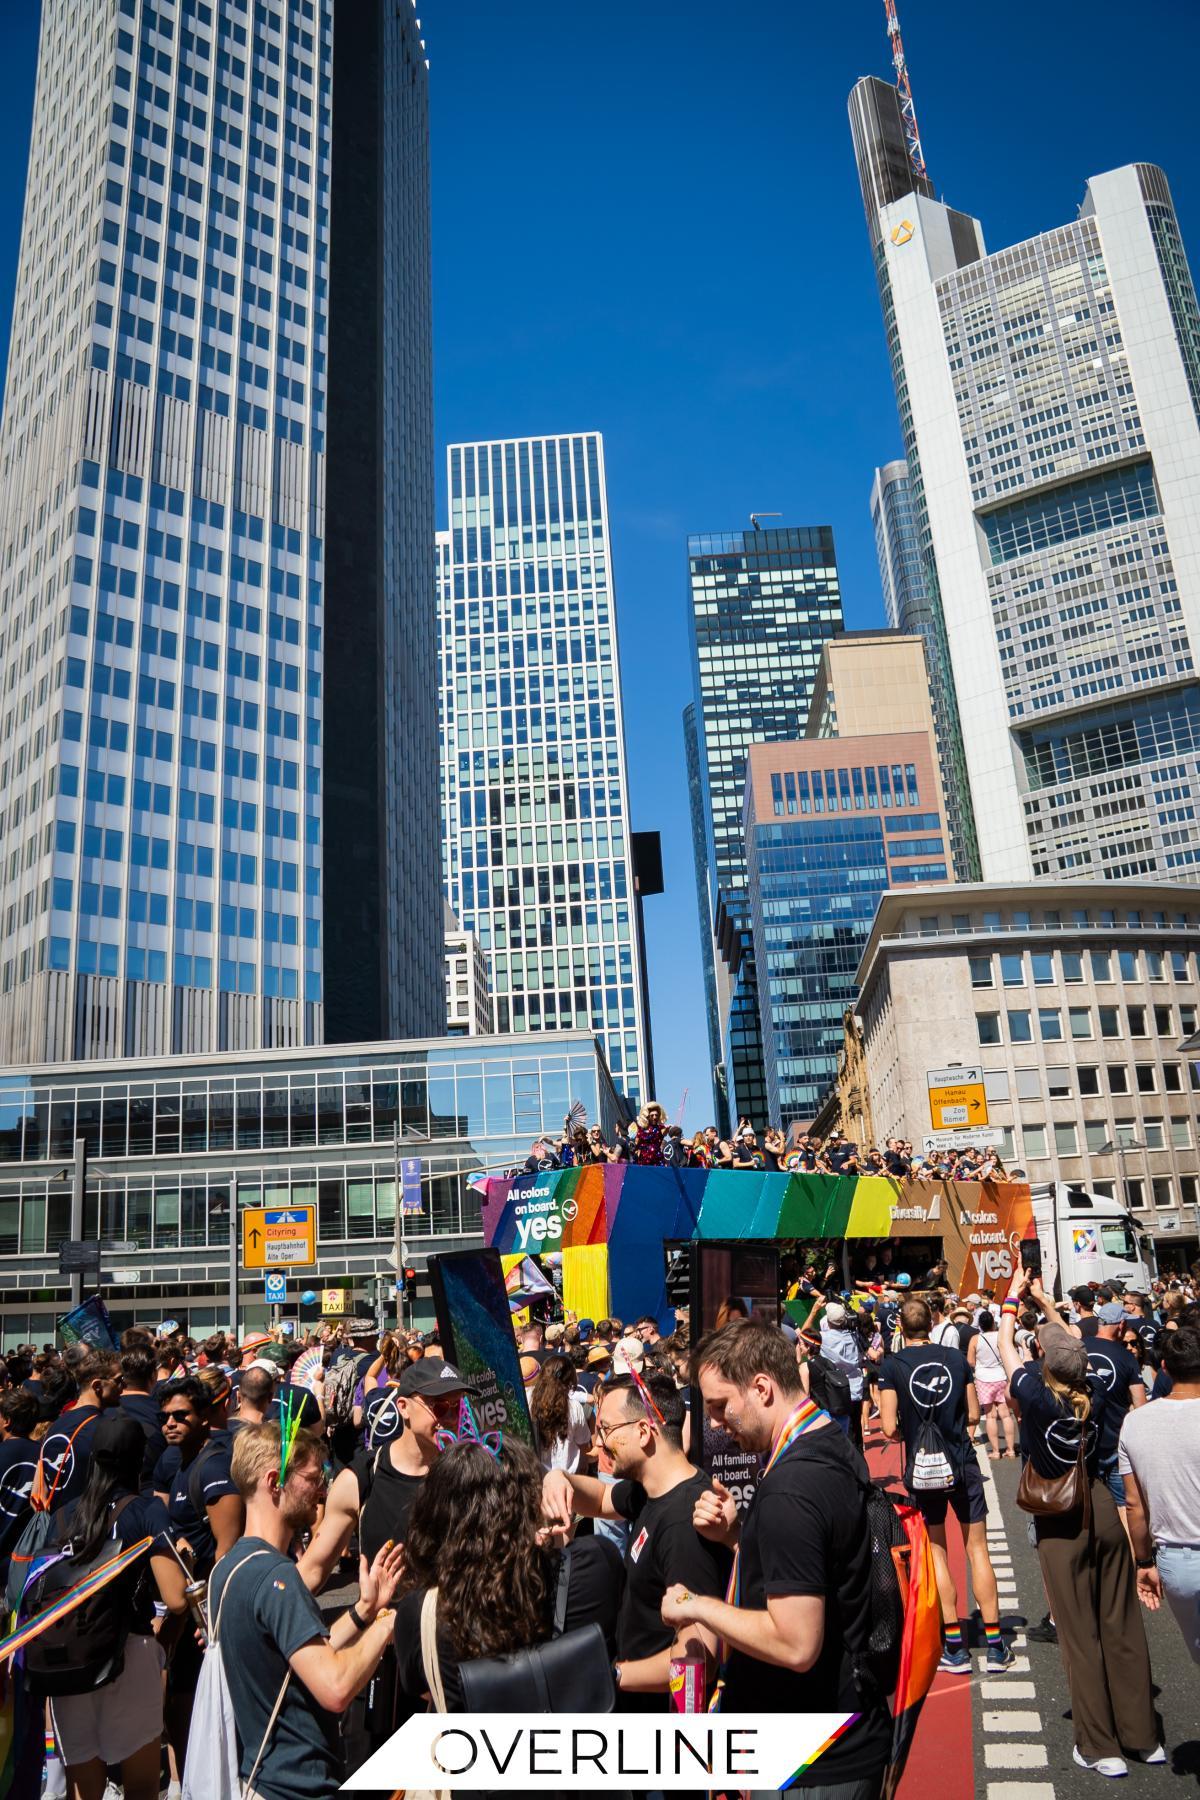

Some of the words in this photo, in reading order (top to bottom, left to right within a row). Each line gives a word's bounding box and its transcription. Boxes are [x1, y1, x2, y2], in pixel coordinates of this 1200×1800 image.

[933, 1097, 967, 1105] Offenbach
[506, 1189, 520, 1201] All
[521, 1187, 550, 1199] colors
[515, 1206, 527, 1215] on
[528, 1199, 559, 1213] board.
[960, 1210, 972, 1225] All
[972, 1210, 998, 1224] colors
[267, 1228, 297, 1237] Cityring
[515, 1215, 562, 1249] yes
[969, 1233, 981, 1245] on
[981, 1229, 1007, 1244] board.
[267, 1241, 306, 1251] Hauptbahnhof
[281, 1252, 294, 1261] Oper
[972, 1249, 1012, 1290] yes
[268, 1292, 284, 1300] TAXI
[323, 1303, 343, 1311] TAXI
[467, 1373, 476, 1385] All
[476, 1368, 496, 1383] colors
[480, 1383, 499, 1398] oard.
[712, 1454, 723, 1467] All
[724, 1453, 757, 1466] families
[712, 1472, 723, 1481] on
[724, 1468, 751, 1481] board.
[728, 1484, 755, 1510] es
